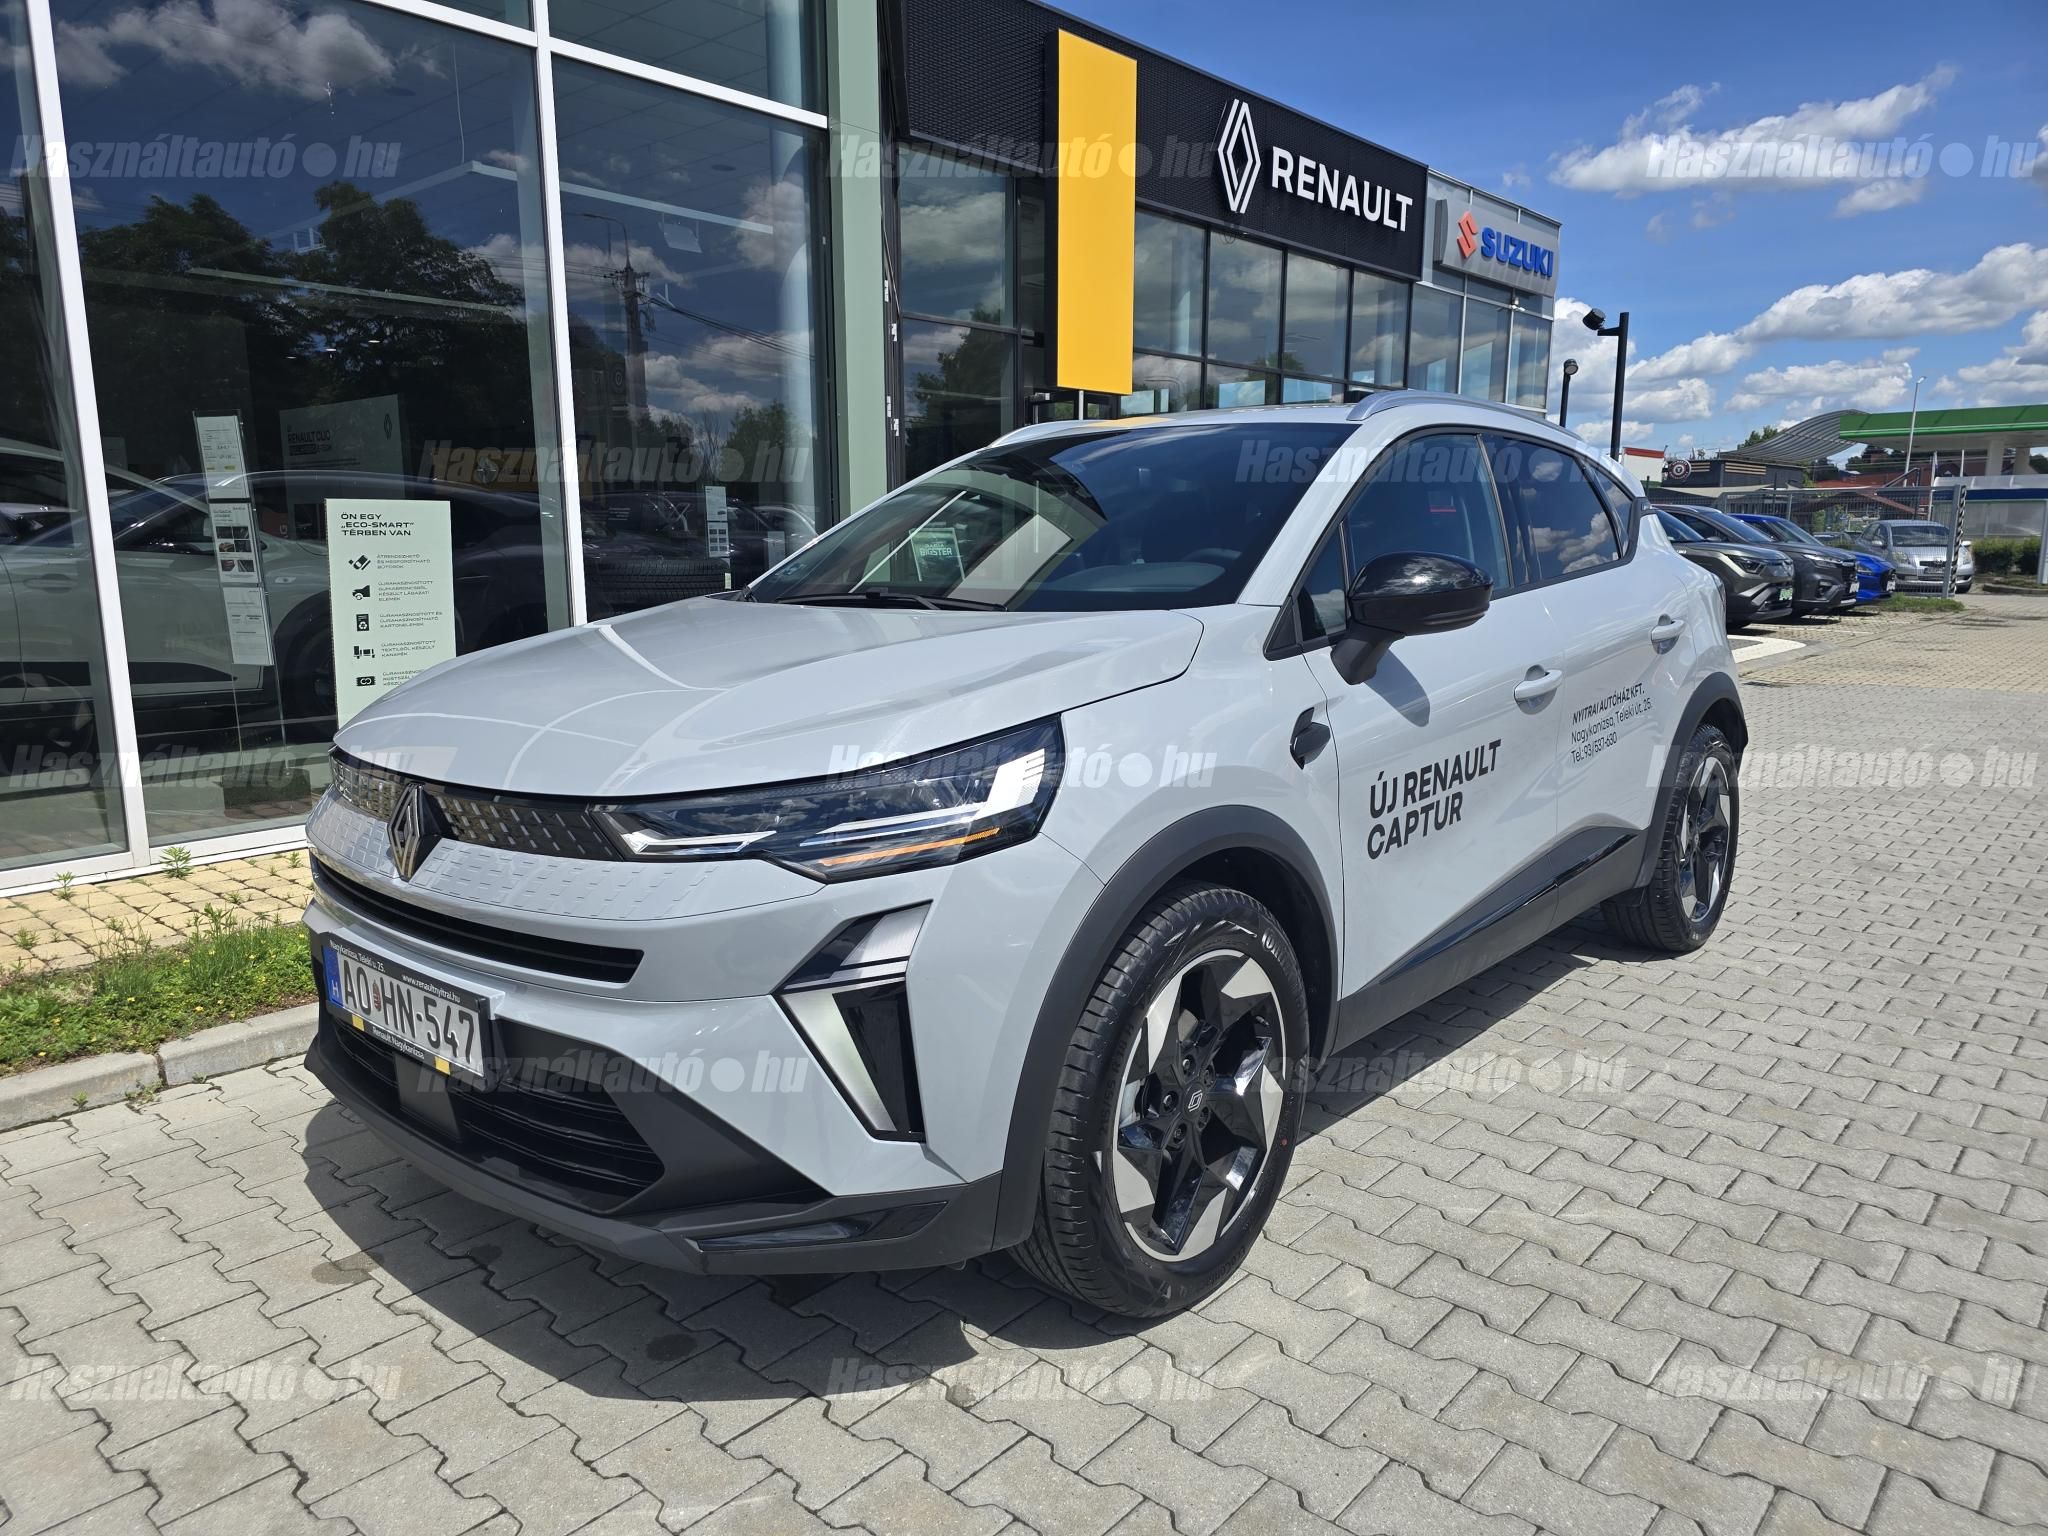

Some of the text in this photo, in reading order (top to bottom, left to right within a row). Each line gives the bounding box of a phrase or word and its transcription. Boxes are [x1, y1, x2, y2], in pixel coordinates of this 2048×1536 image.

[1272, 146, 1413, 232] RENAULT
[1481, 227, 1555, 278] SUZUKI
[341, 512, 357, 520] ÖN
[920, 547, 952, 556] BIGSTER
[1571, 716, 1616, 745] Nagykanizsa,
[1615, 703, 1635, 723] Teleki
[1572, 682, 1645, 725] NYITRAI AUTÓHÁZ KFT.
[1370, 739, 1502, 819] ÚJ RENAULT
[1367, 791, 1464, 860] CAPTUR
[332, 980, 340, 999] H
[401, 974, 461, 1004] www.renaultnyitrai.hu
[379, 976, 475, 1065] HN-547
[372, 1026, 425, 1060] Renault Nagykanizsa
